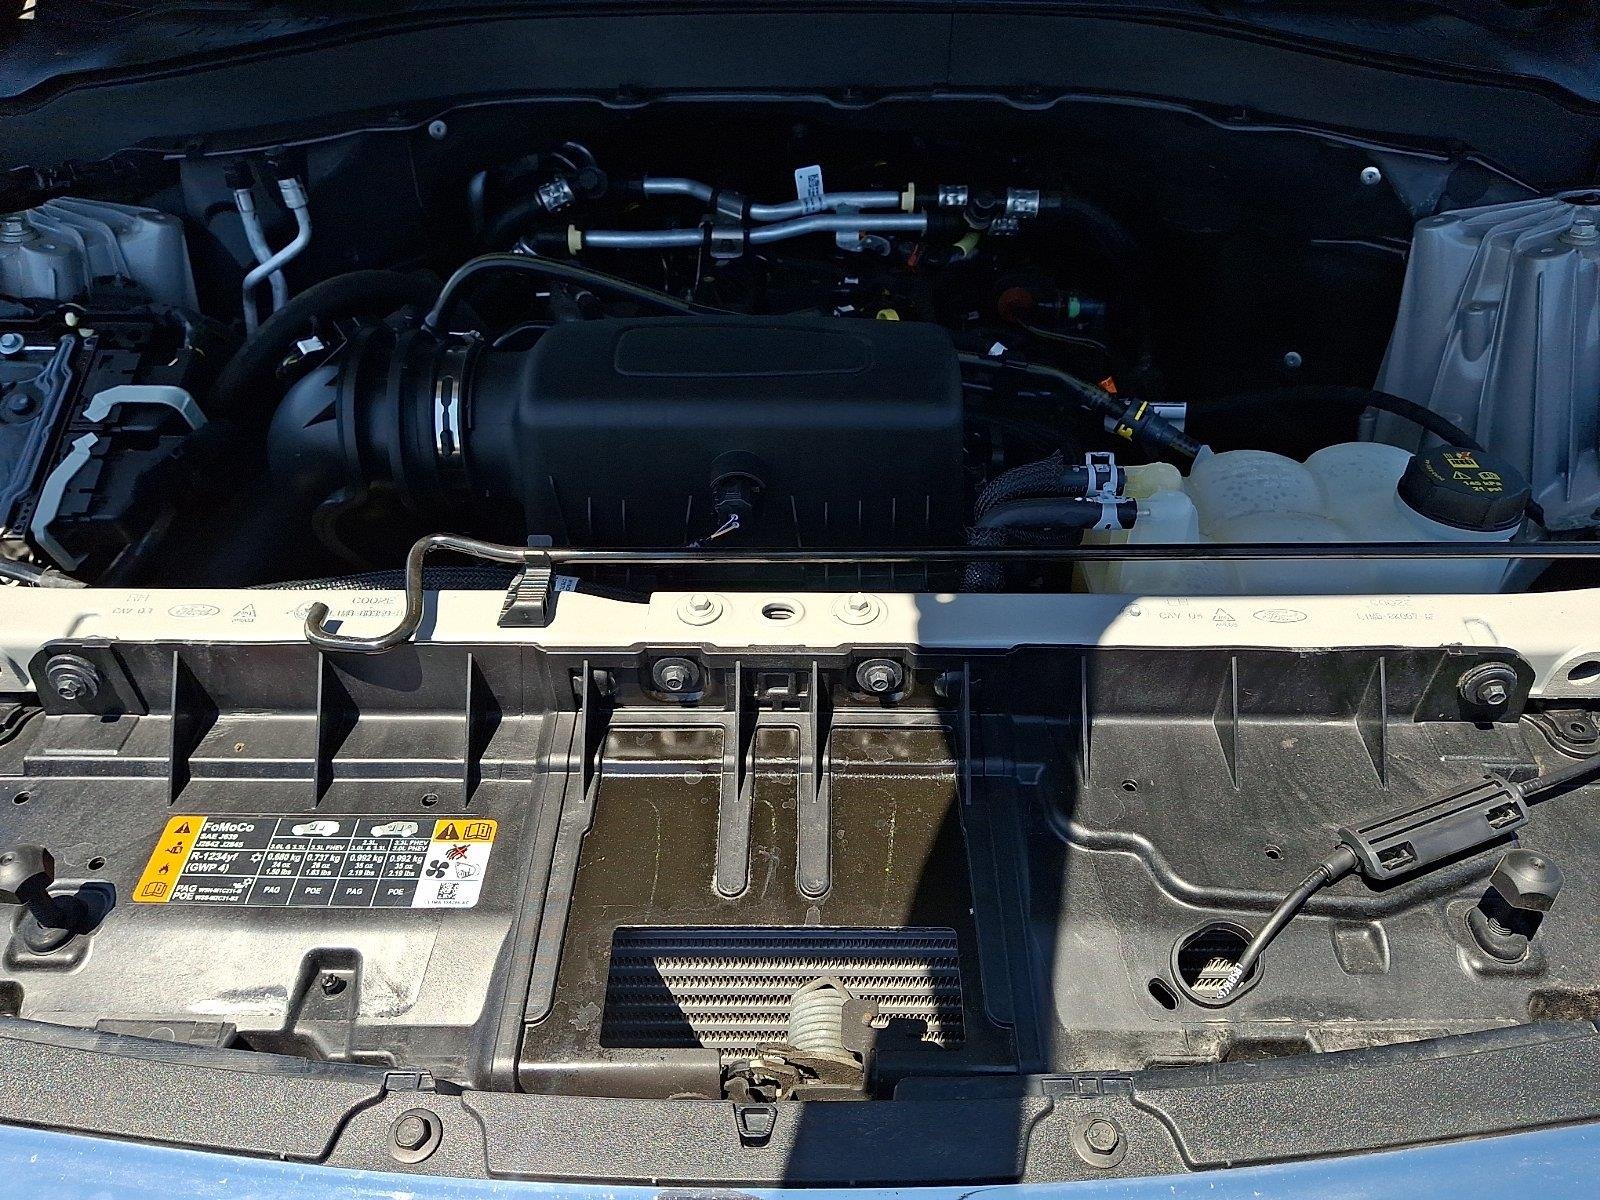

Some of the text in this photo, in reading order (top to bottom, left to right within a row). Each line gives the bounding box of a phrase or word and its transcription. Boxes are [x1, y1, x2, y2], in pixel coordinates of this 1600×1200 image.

[202, 821, 255, 833] FoMoCo
[190, 851, 239, 862] R-1234yf
[267, 853, 302, 862] 0.680 kg
[306, 853, 341, 863] 0.737 kg
[350, 854, 384, 863] 0.992 kg
[389, 855, 423, 864] 0.992 kg
[184, 862, 230, 873] (GWP 4)
[175, 884, 198, 893] PAG
[262, 885, 281, 894] PAG
[304, 886, 322, 895] POE
[346, 887, 363, 895] PAG
[387, 888, 404, 896] POE
[172, 892, 195, 901] POE
